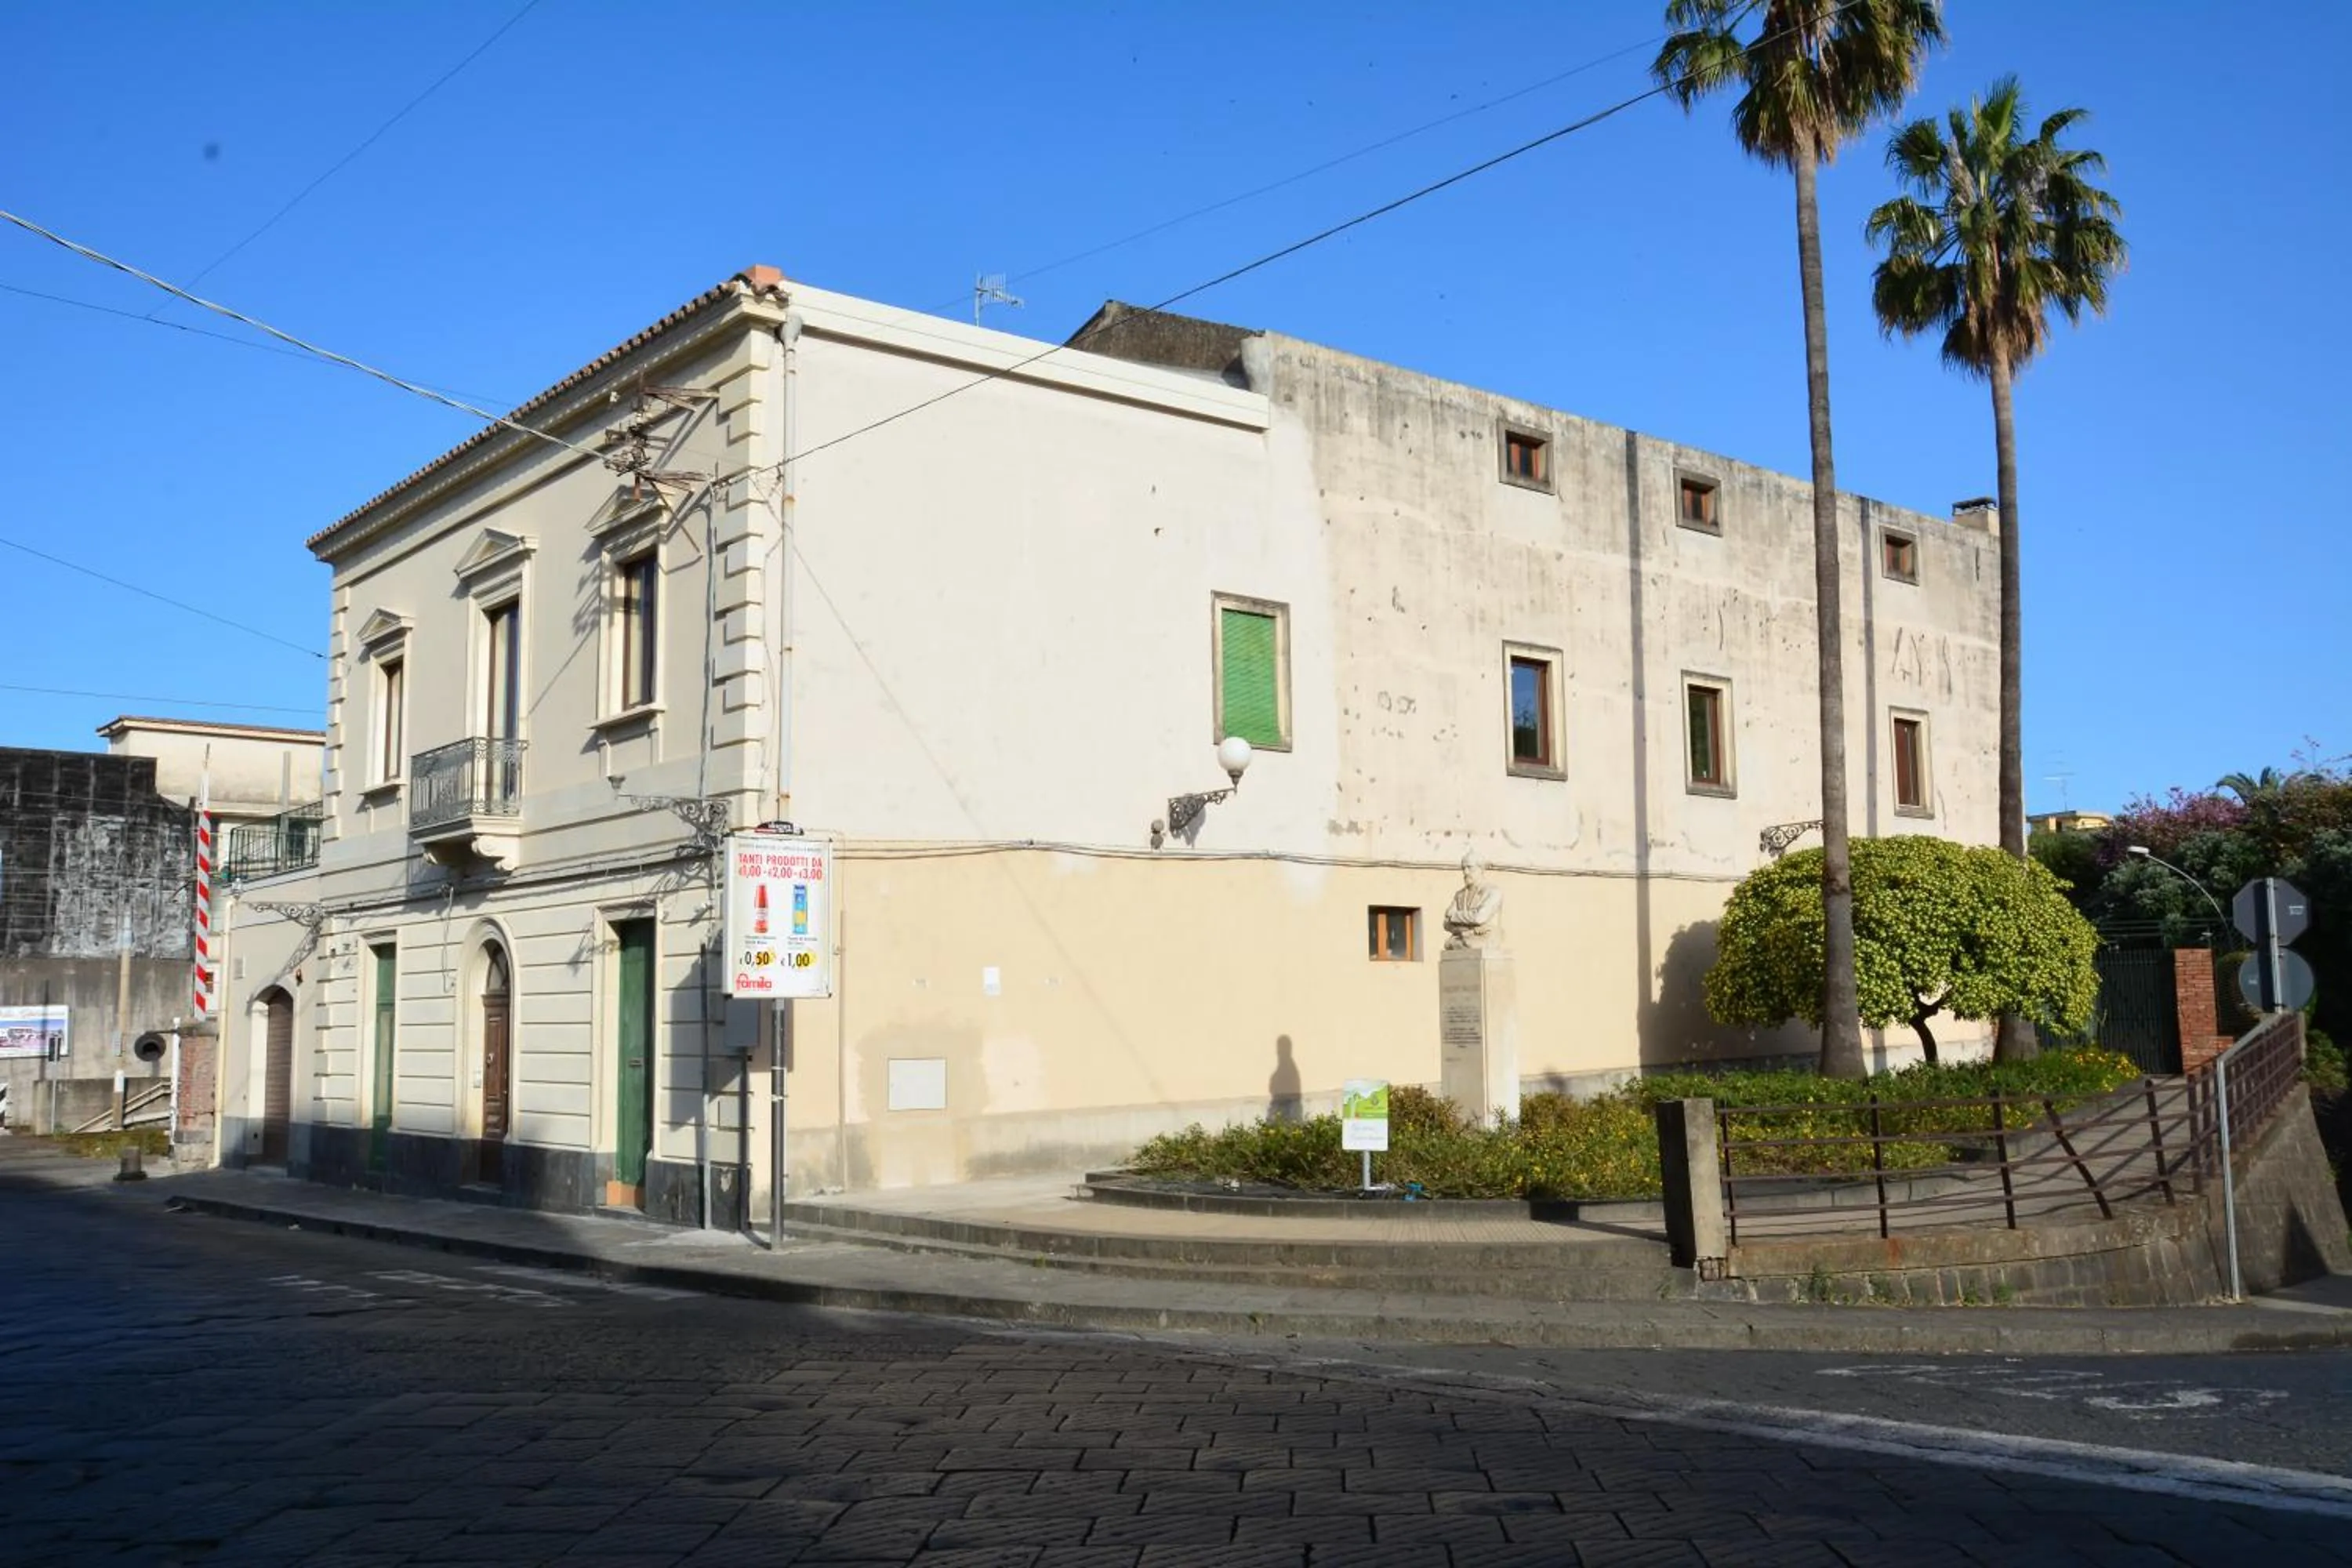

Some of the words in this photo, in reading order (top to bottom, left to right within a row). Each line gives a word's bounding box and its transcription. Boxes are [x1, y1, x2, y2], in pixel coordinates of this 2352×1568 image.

[739, 853, 762, 864] TANTI
[767, 855, 808, 867] PRODOTTI
[811, 856, 822, 868] DA
